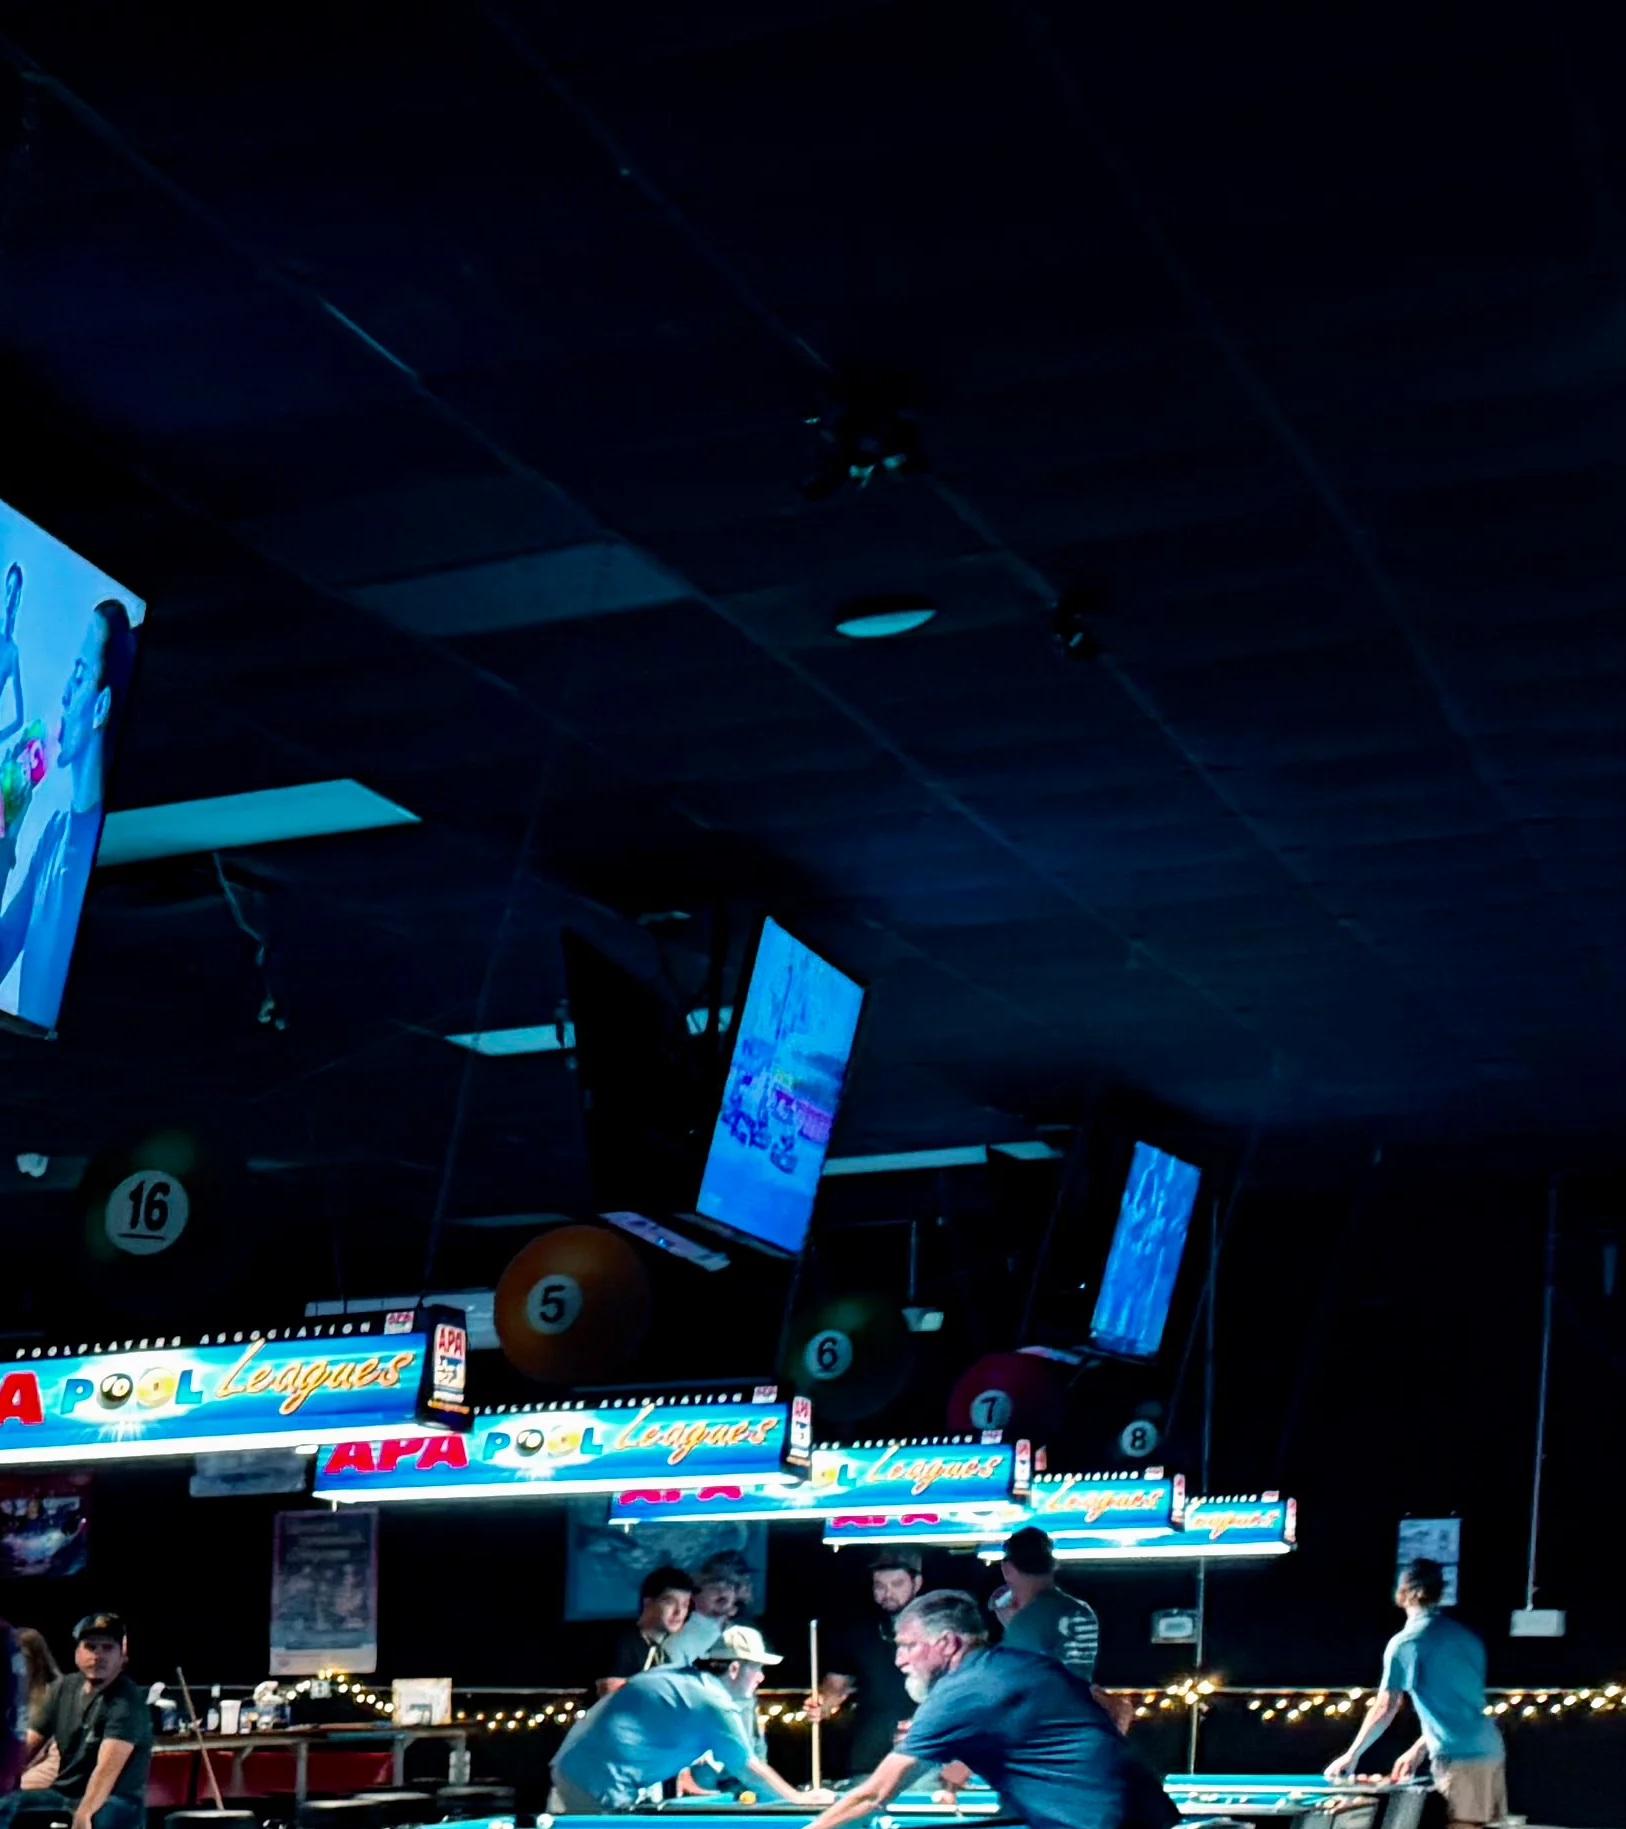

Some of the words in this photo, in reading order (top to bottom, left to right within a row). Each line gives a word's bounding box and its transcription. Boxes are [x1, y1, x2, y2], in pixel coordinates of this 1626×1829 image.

[128, 1180, 171, 1231] 16
[539, 1284, 567, 1324] 5
[60, 1366, 204, 1415] POOL
[215, 1337, 415, 1416] Leagues
[816, 1336, 839, 1369] 6
[979, 1396, 998, 1424] 7
[322, 1432, 469, 1474] APA
[615, 1402, 779, 1466] Leagues
[867, 1444, 1004, 1496] Leagues
